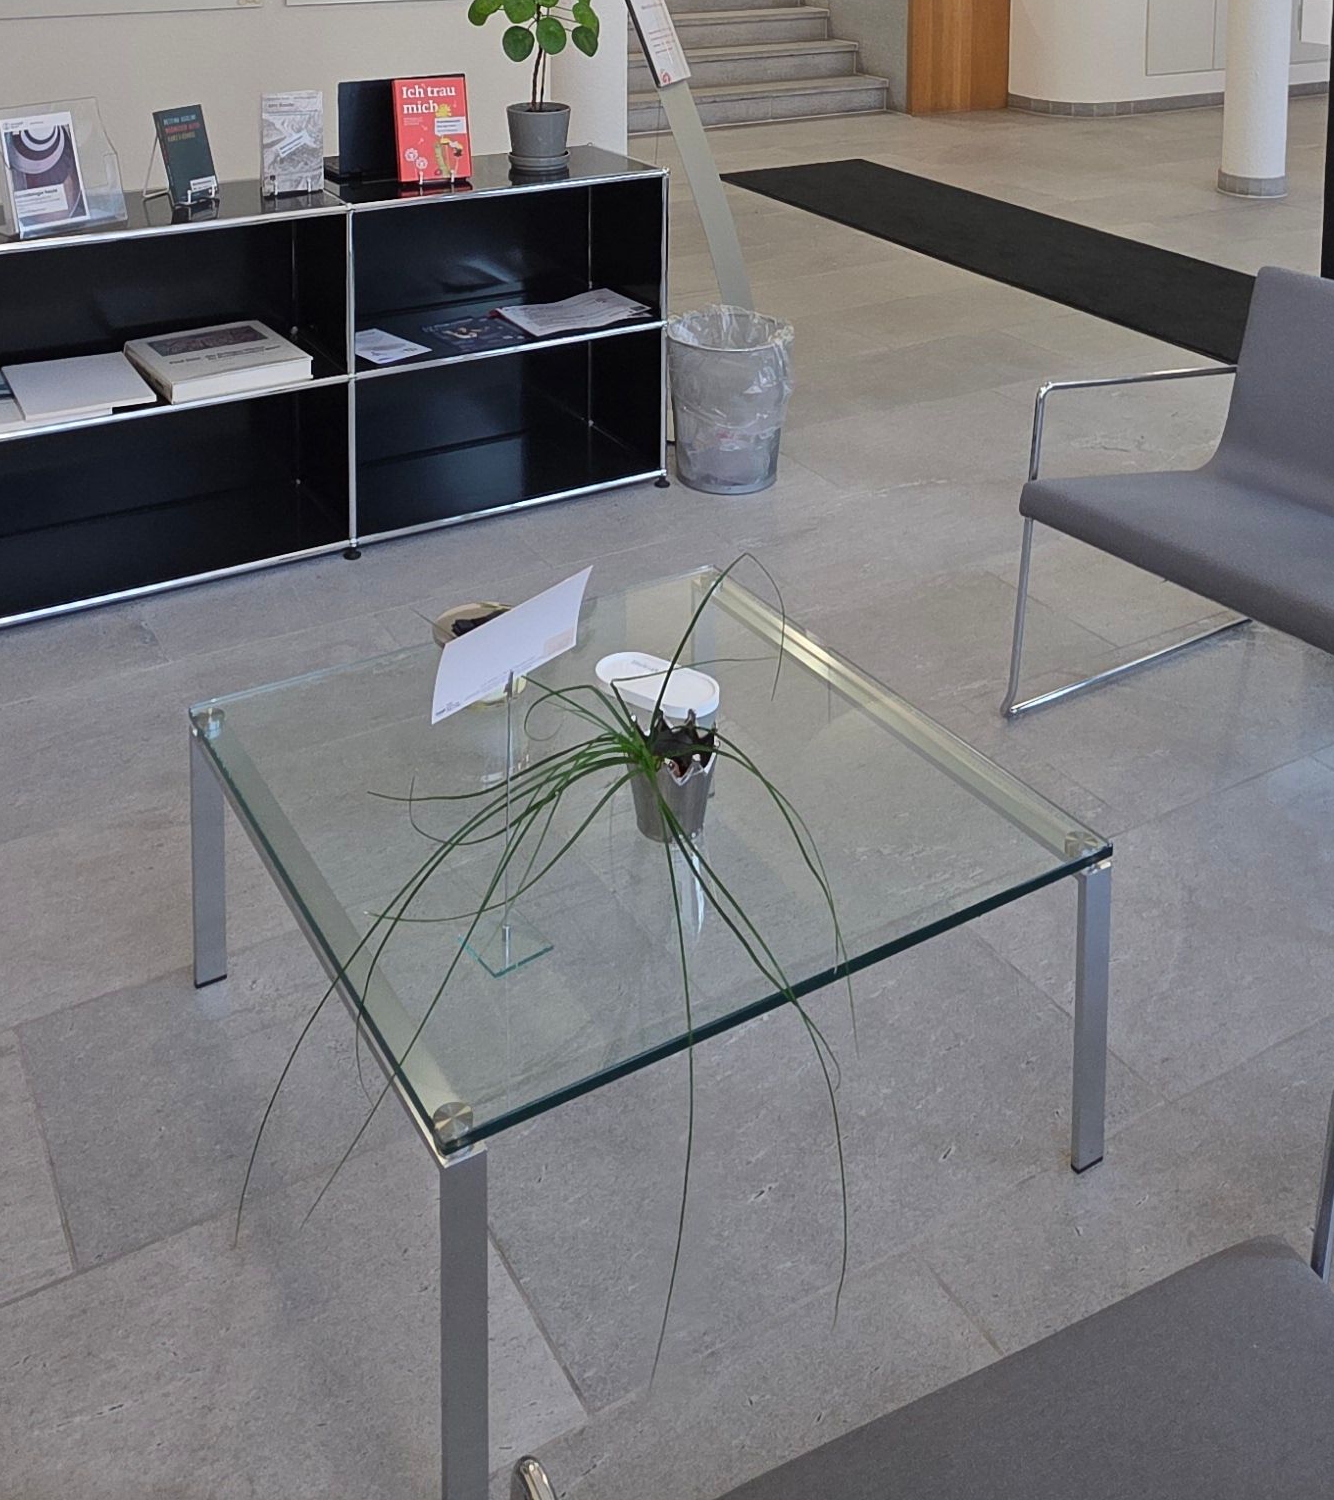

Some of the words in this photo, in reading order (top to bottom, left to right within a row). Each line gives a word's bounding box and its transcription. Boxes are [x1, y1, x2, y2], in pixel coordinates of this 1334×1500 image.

[402, 85, 425, 98] Ich
[427, 86, 456, 97] trau
[403, 100, 439, 114] mich
